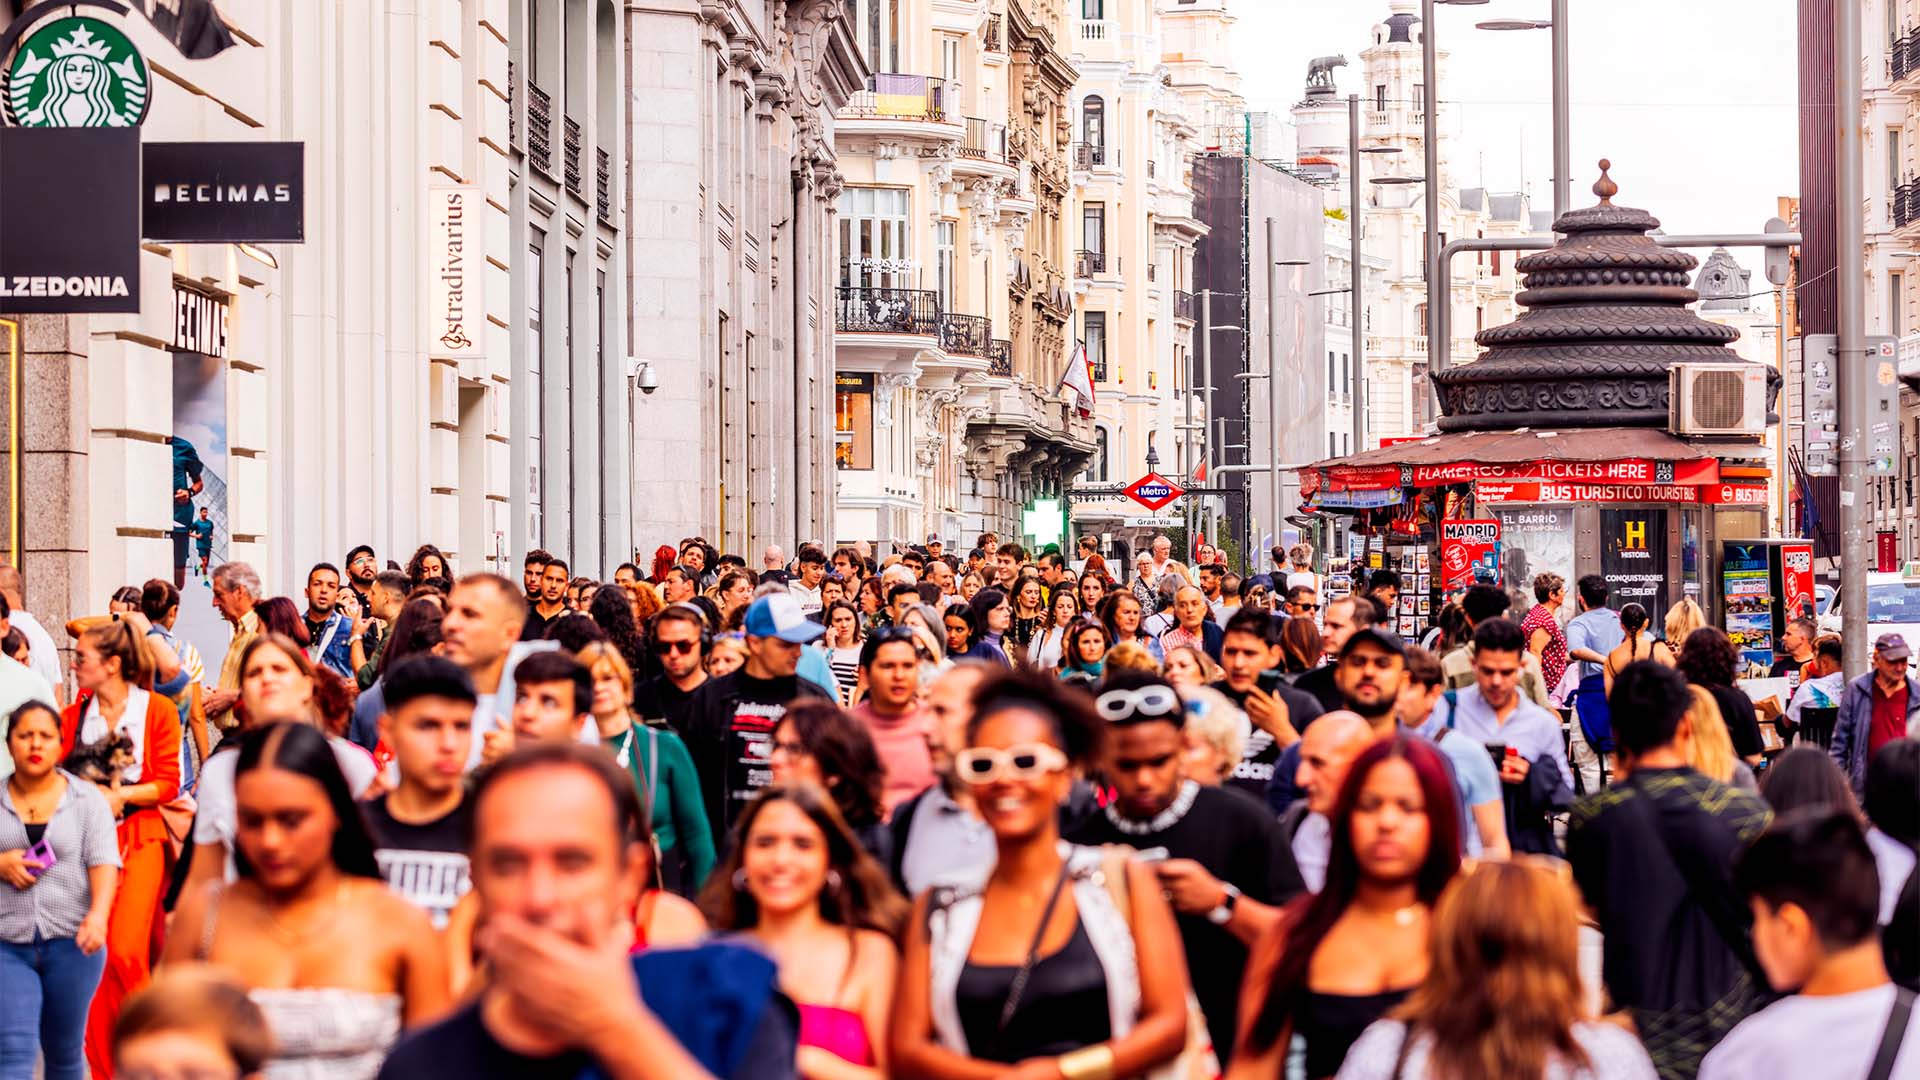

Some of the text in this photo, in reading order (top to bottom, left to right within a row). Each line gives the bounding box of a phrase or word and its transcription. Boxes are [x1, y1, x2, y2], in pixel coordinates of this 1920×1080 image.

[441, 193, 464, 335] stradivarius
[0, 275, 130, 297] LZEDONIA
[1417, 466, 1505, 481] FLAMENCO
[1540, 463, 1603, 477] TICKETS
[1608, 463, 1647, 479] HERE
[1140, 487, 1168, 496] Metro
[1542, 486, 1695, 500] BUS TURISTICO TOURIST BUS
[1137, 518, 1156, 526] Gran
[1503, 514, 1557, 524] EL BARRIO
[1445, 524, 1497, 538] MADRID
[1625, 521, 1646, 549] H
[1605, 574, 1664, 583] CONQUISTADORES
